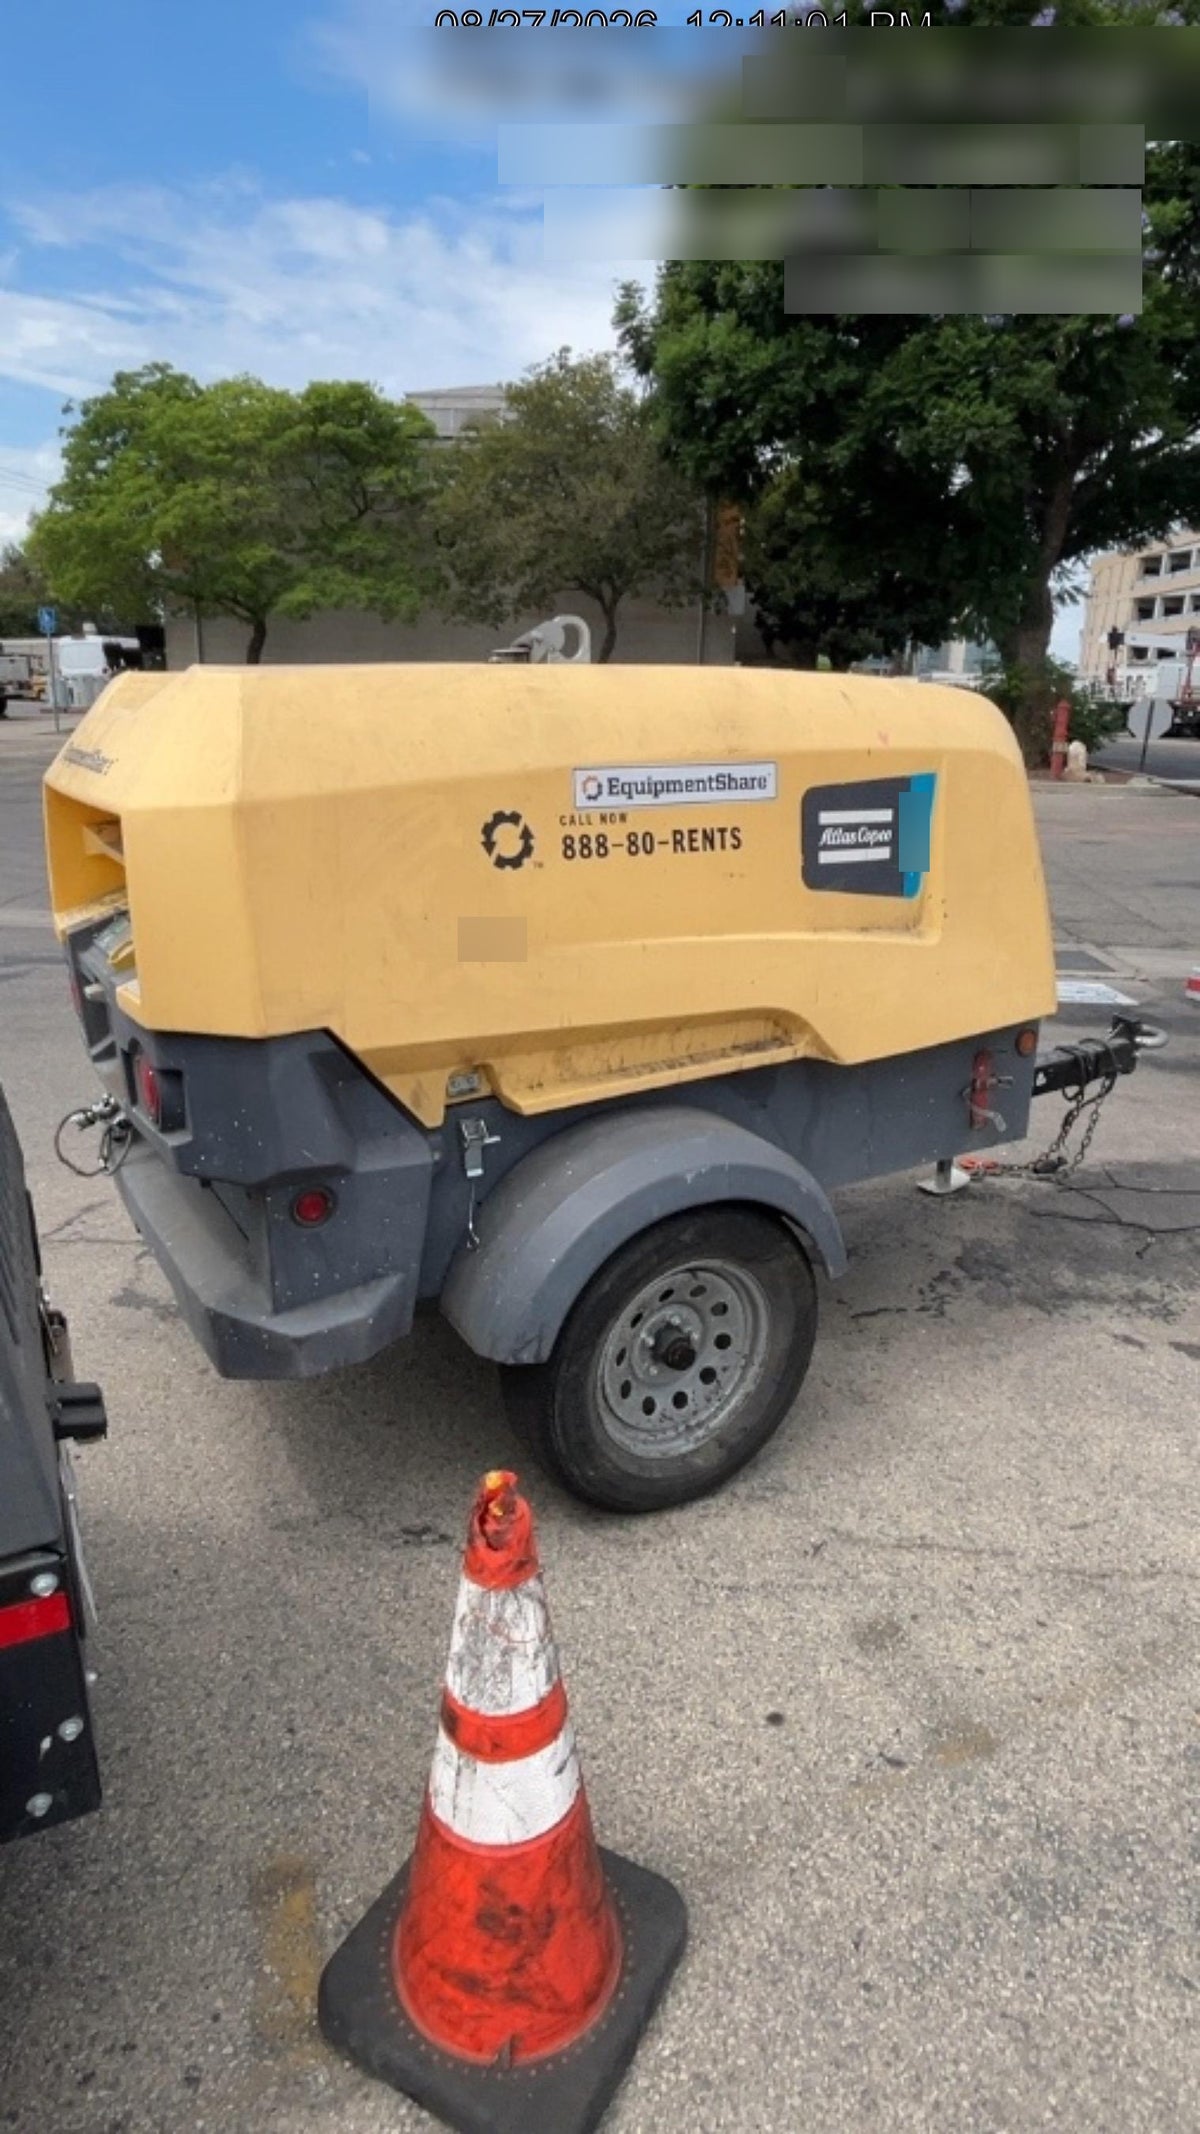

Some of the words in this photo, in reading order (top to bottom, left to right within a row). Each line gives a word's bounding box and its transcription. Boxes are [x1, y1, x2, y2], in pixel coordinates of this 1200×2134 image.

[607, 772, 767, 799] EquipmentShare
[559, 813, 593, 826] CALL
[600, 812, 628, 825] NOW
[562, 827, 742, 860] 888-80-RENTS
[818, 827, 857, 846] Atlas
[857, 826, 893, 846] Copco
